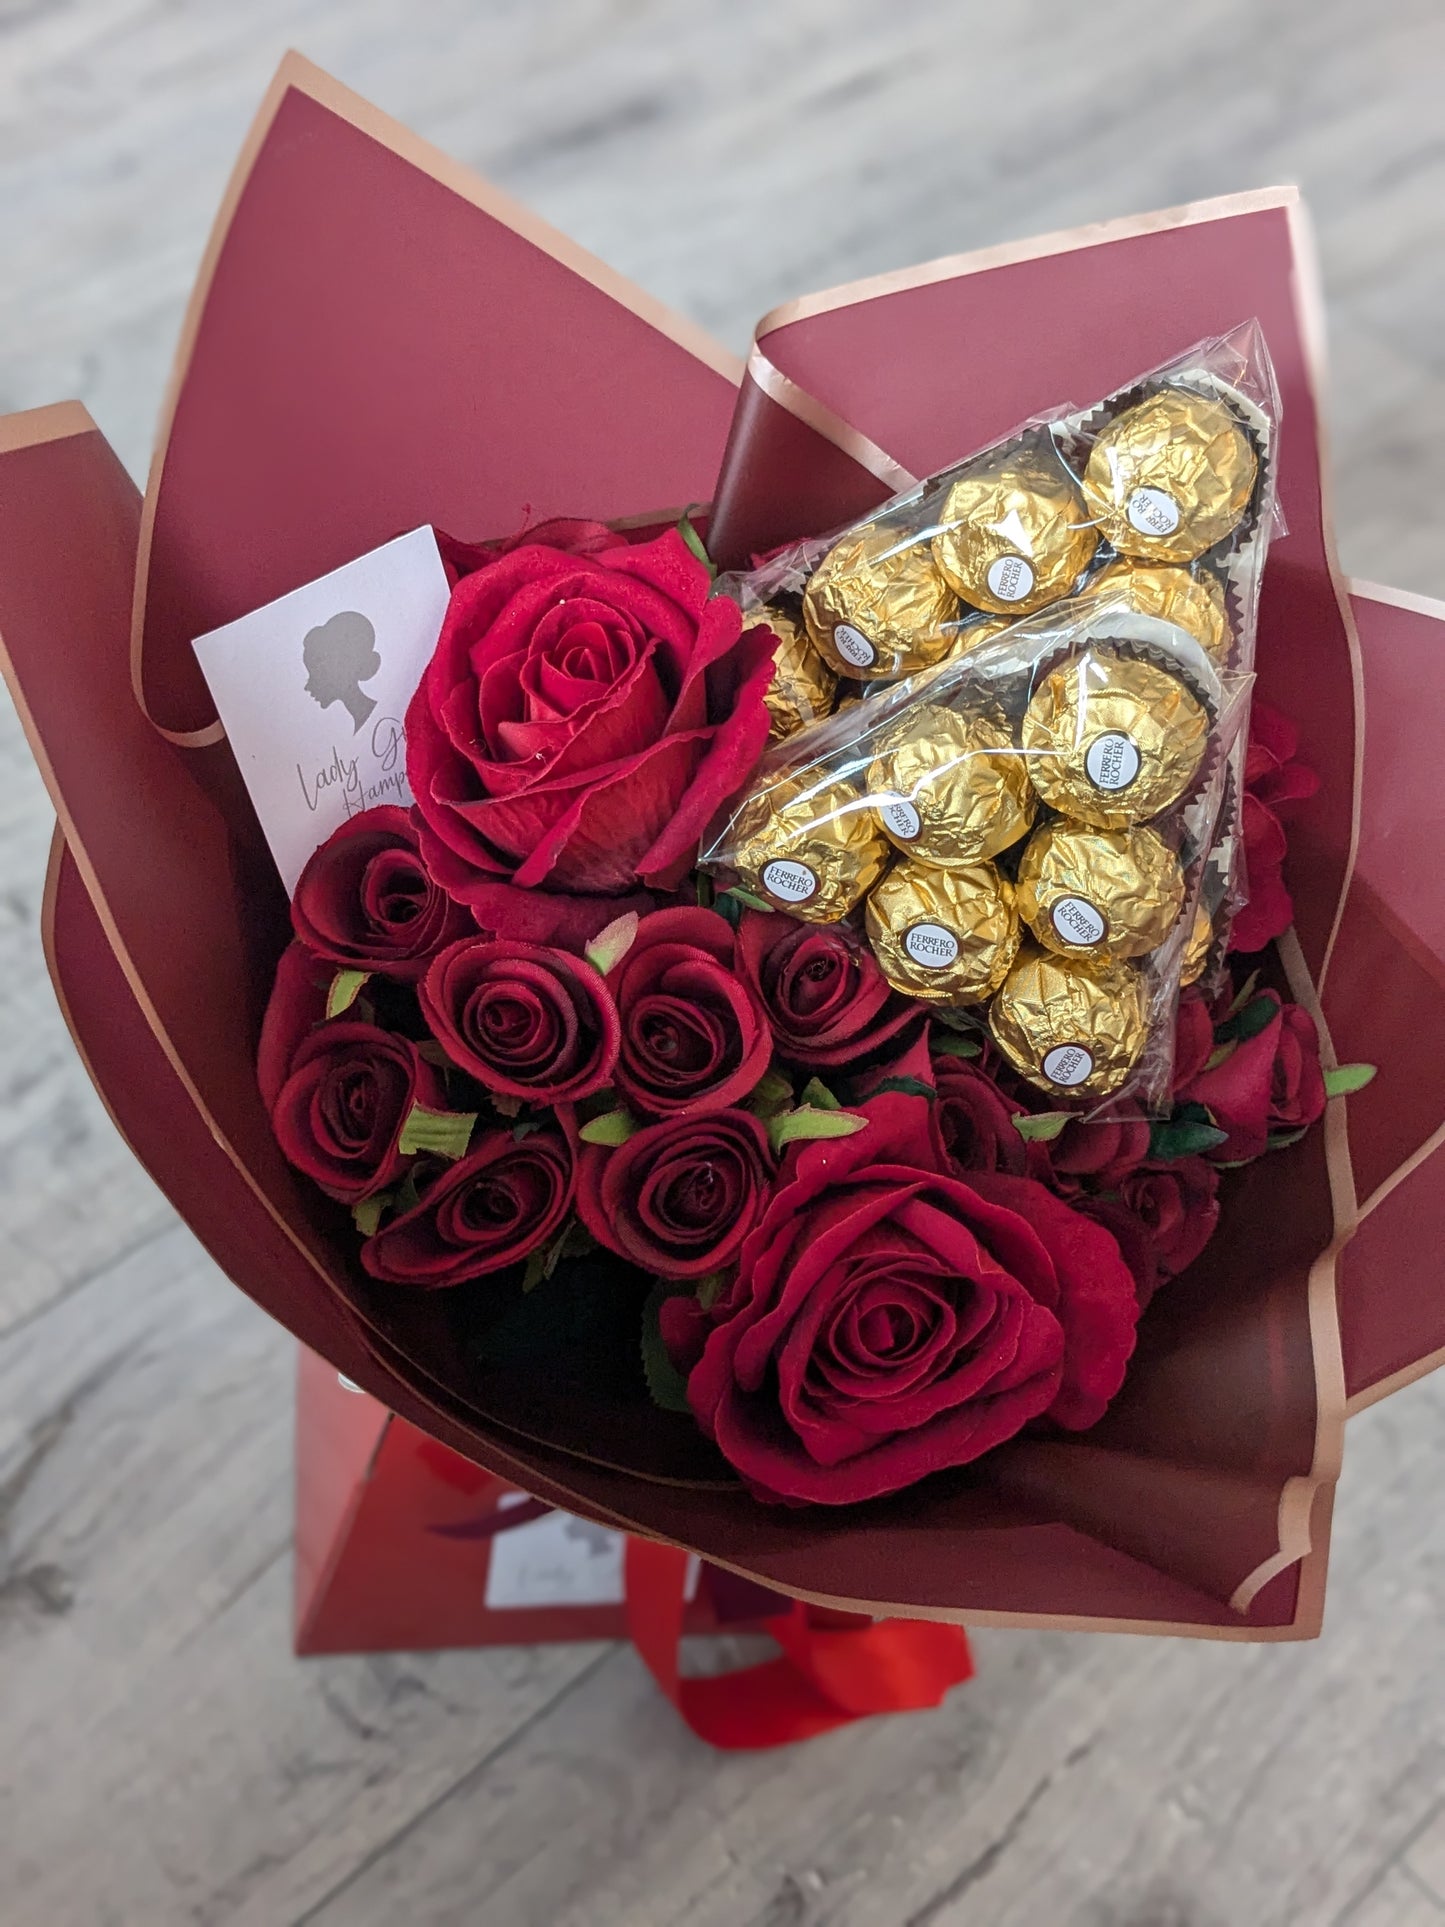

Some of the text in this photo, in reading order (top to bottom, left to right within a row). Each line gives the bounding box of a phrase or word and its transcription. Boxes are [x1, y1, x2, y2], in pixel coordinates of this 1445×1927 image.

[1132, 499, 1167, 533] FERRRO
[997, 558, 1014, 596] FERRERO
[1006, 562, 1023, 598] ROCHER
[297, 745, 360, 811] Lady
[1099, 738, 1115, 784] FERRERO
[1109, 741, 1126, 785] ROCHER
[342, 771, 408, 818] Hamp
[766, 873, 809, 895] ROCHER
[770, 865, 813, 887] FERRERO
[1057, 906, 1093, 942] ROCHER
[1064, 901, 1100, 936] FERRERO
[910, 941, 954, 957] ROCHER
[911, 932, 955, 949] FERRERO
[1050, 1048, 1076, 1080] FERRERO
[1058, 1052, 1086, 1083] ROCHER
